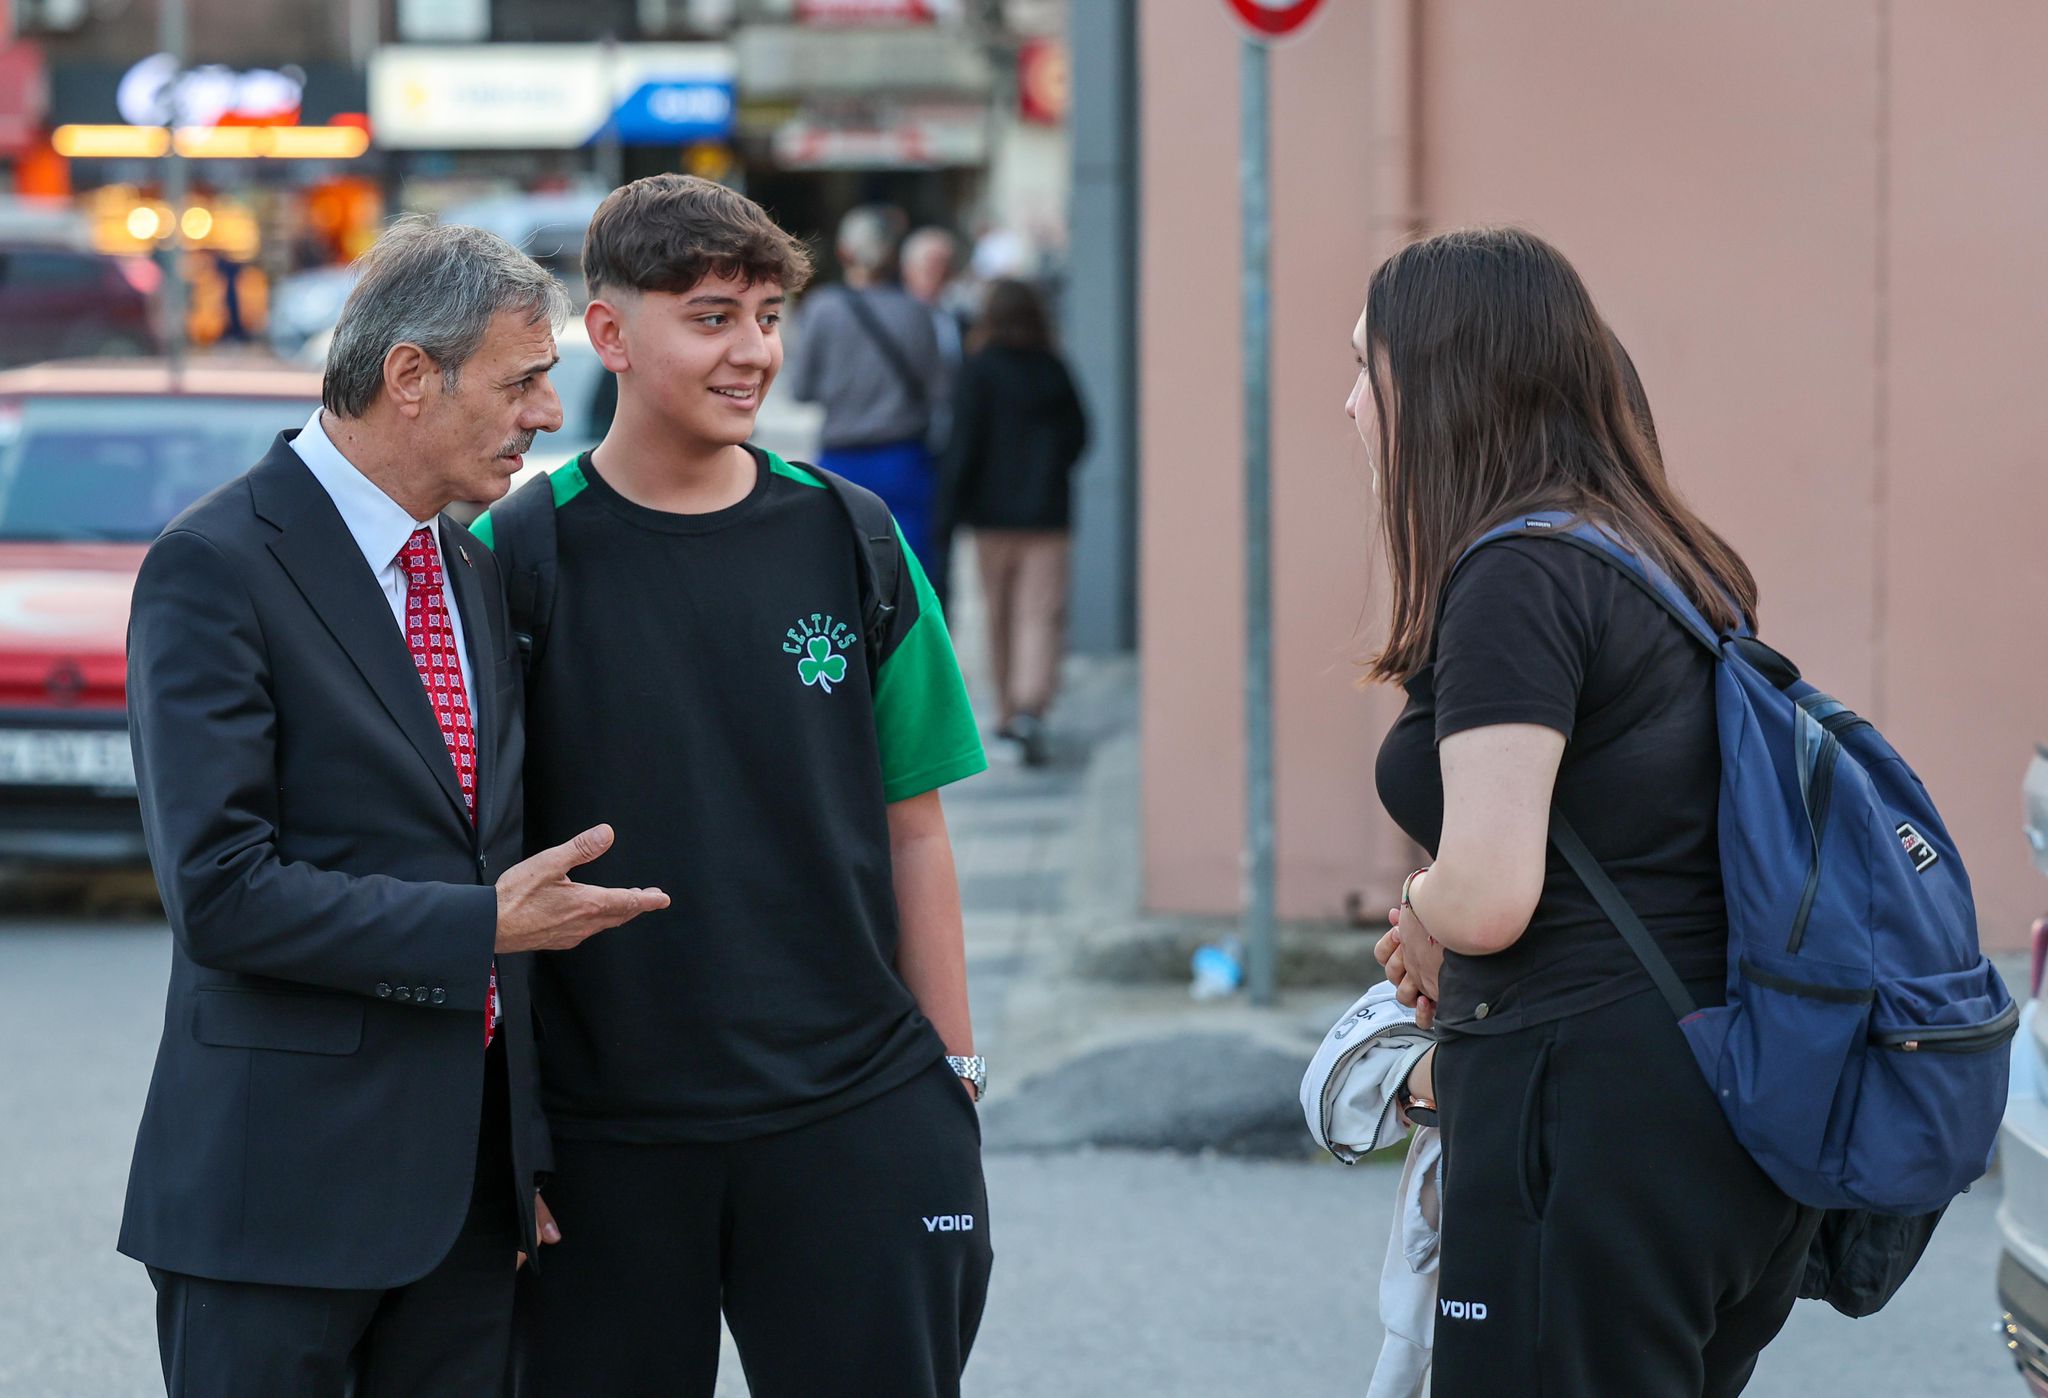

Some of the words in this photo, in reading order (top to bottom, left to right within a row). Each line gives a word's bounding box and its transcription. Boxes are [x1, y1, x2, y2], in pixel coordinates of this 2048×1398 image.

[782, 613, 857, 655] CELTICS
[922, 1214, 974, 1232] VOID
[1440, 1298, 1487, 1320] VOID
